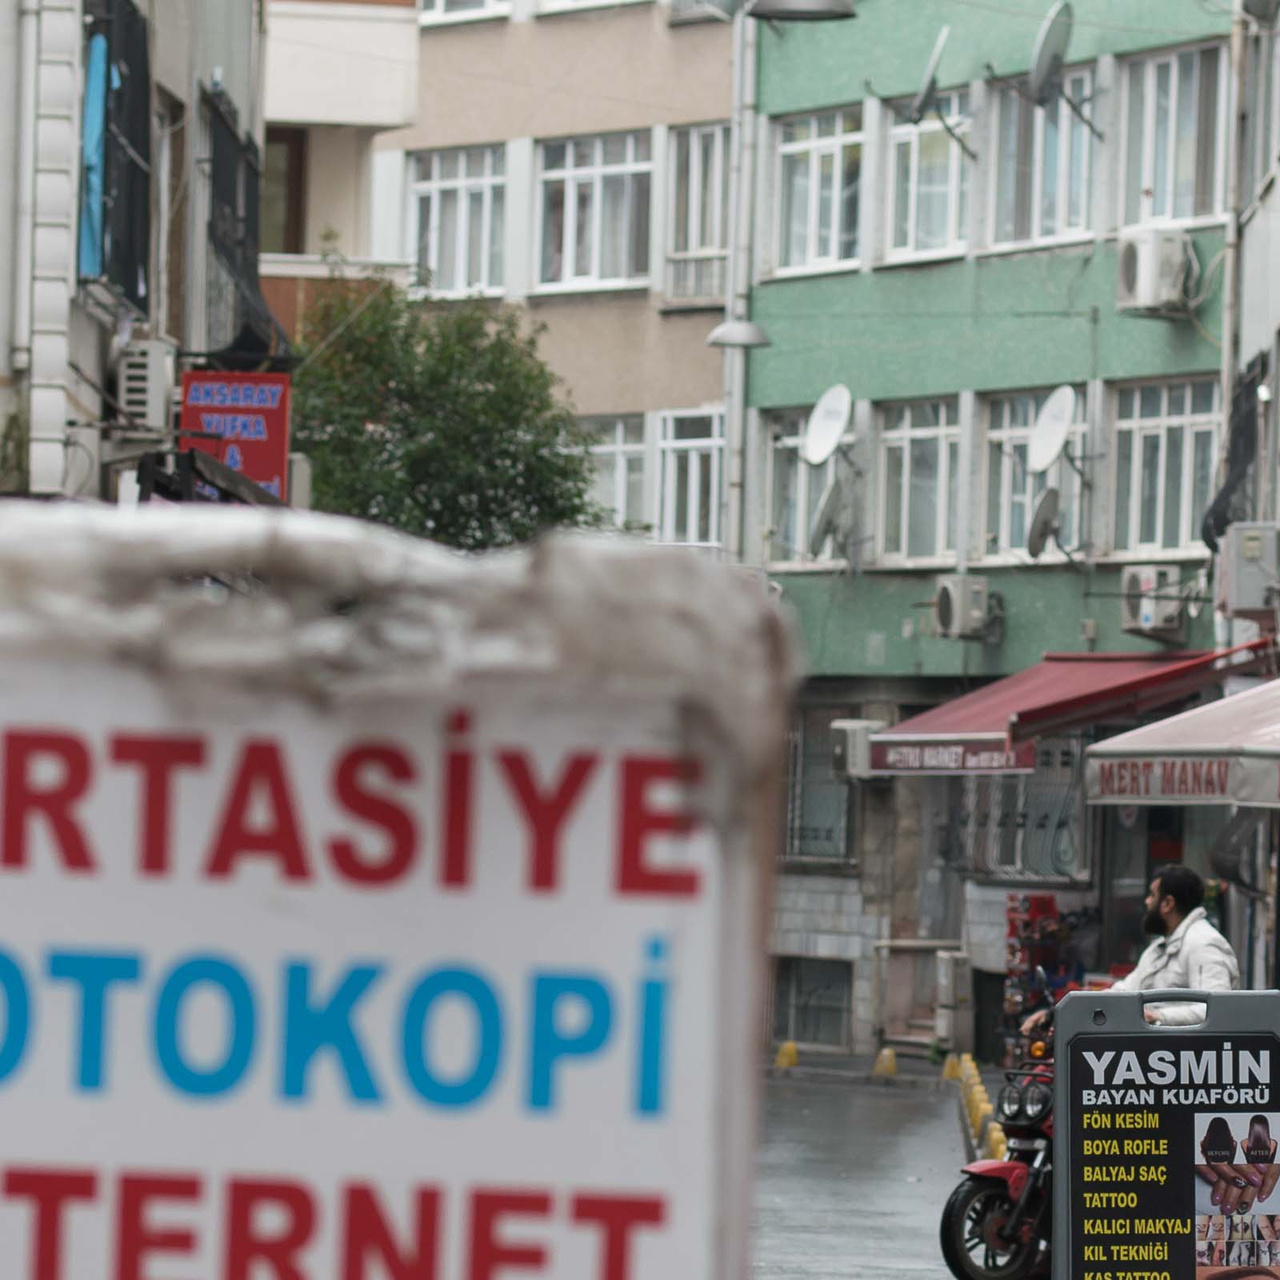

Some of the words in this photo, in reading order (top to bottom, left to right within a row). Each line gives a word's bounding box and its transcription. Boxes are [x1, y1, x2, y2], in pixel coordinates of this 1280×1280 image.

[188, 382, 283, 408] AKSARAY
[200, 413, 269, 441] YUFKA
[1099, 760, 1154, 796] MERT
[1159, 759, 1230, 796] MANAV
[1082, 1042, 1270, 1085] YASMİN
[1082, 1089, 1155, 1106] BAYAN
[1162, 1086, 1270, 1105] KUAFÖRÜ
[1083, 1110, 1112, 1129] FÖN
[1115, 1109, 1159, 1129] KESİM
[1083, 1139, 1120, 1155] BOYA
[1124, 1139, 1168, 1155] ROFLE
[1083, 1165, 1135, 1182] BALYAJ
[1139, 1166, 1167, 1185] SAÇ
[1083, 1192, 1138, 1208] TATTOO
[1084, 1219, 1130, 1235] KALICI
[1134, 1218, 1192, 1235] MAKYAJ
[1084, 1245, 1107, 1261] KIL
[1111, 1242, 1168, 1261] TEKNİĞİ
